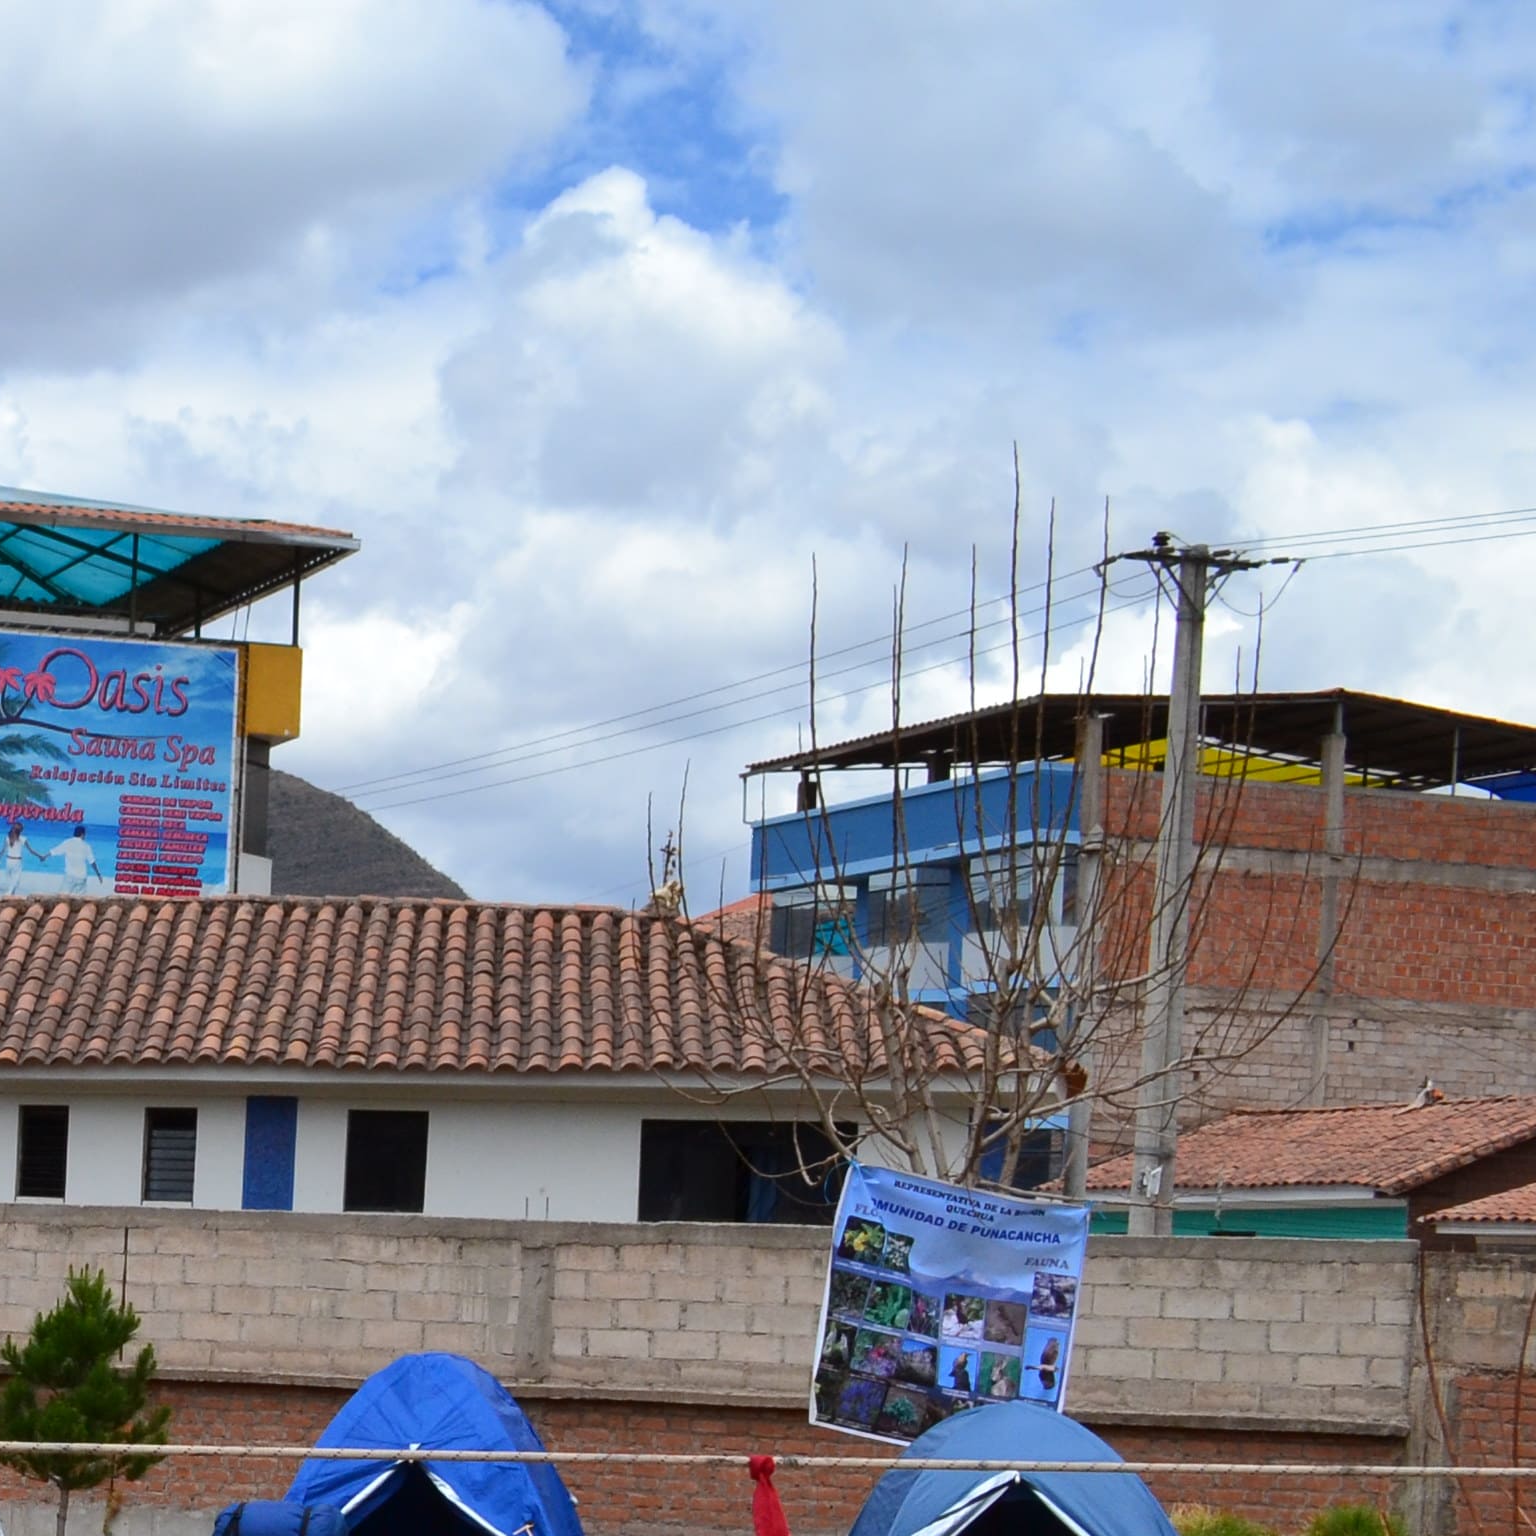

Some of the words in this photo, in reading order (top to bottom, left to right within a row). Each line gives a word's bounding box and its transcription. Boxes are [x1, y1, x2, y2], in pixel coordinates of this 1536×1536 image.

[37, 647, 190, 716] Oasis
[68, 728, 156, 760] Sauna
[164, 735, 216, 773] Spa
[30, 765, 125, 785] Relajación
[129, 772, 157, 787] Sin
[894, 1181, 980, 1208] REPRESENTATIVA
[984, 1203, 997, 1213] DE
[1000, 1207, 1012, 1216] LA
[948, 1220, 967, 1232] DE
[970, 1225, 1061, 1244] PUNACANCHA
[1024, 1257, 1069, 1269] FAUNA
